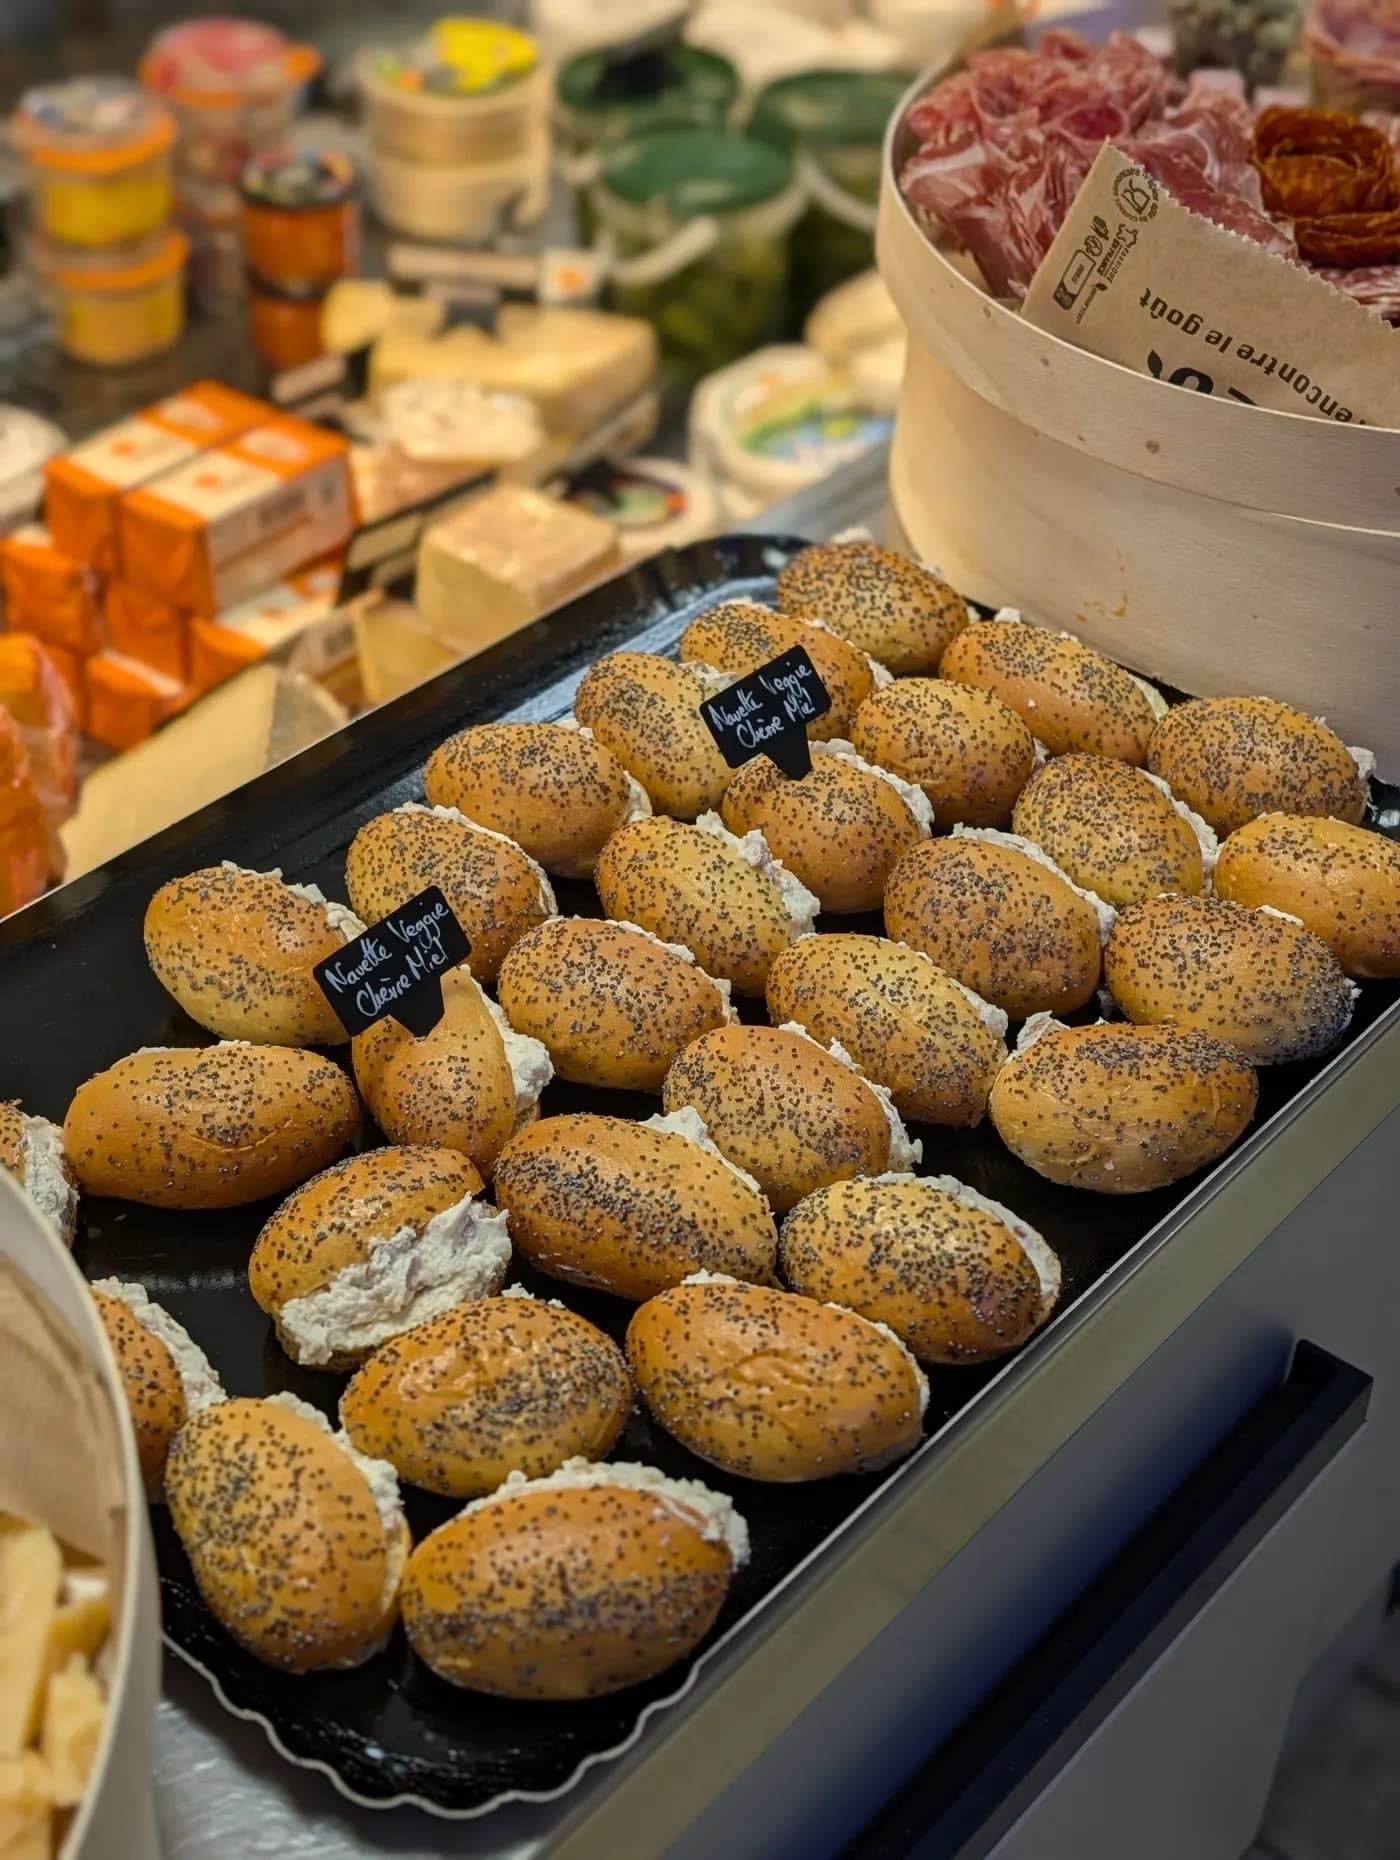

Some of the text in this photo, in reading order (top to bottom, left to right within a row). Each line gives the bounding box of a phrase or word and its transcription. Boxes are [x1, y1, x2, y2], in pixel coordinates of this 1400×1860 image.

[1139, 288, 1204, 335] goût
[1205, 329, 1233, 354] le
[1237, 343, 1366, 425] encontre
[758, 661, 812, 700] Veggie
[783, 687, 815, 722] Miel
[325, 902, 449, 994] Navette Veggie
[406, 936, 449, 981] Miel
